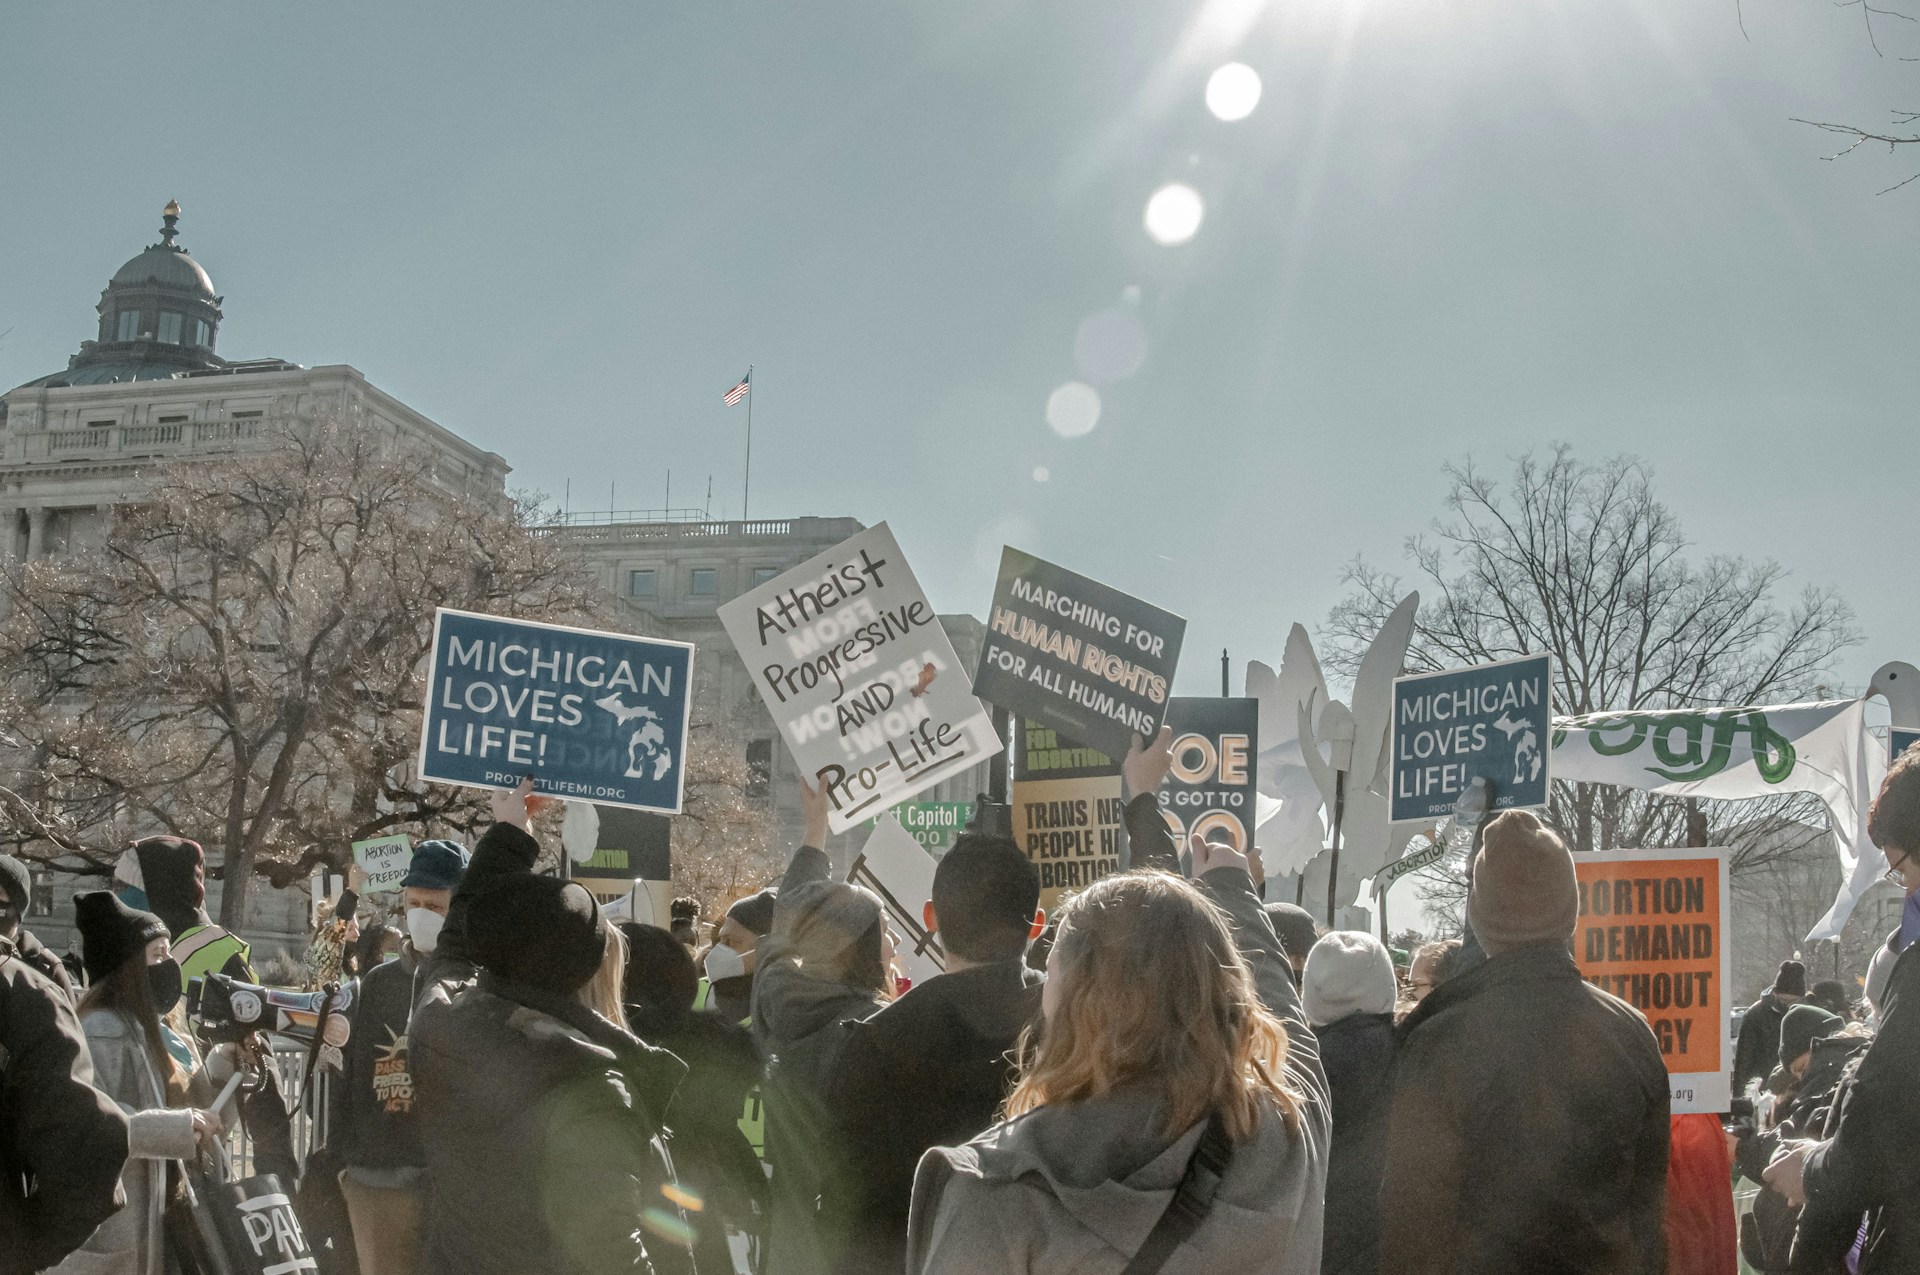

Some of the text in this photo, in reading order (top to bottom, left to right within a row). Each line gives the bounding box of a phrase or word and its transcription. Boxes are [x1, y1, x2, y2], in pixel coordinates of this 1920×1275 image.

[757, 549, 886, 646] Atheist
[1011, 577, 1165, 658] MARCHING FOR
[447, 635, 672, 697] MICHIGAN
[763, 601, 936, 703] Progressive
[992, 606, 1167, 705] HUMAN RIGHTS
[443, 676, 583, 726] LOVES
[836, 682, 894, 737] AND
[986, 645, 1027, 678] FOR
[1029, 665, 1063, 695] ALL
[1068, 680, 1155, 736] HUMANS
[1401, 677, 1539, 725] MICHIGAN
[438, 719, 547, 767] LIFE!
[1161, 732, 1249, 785] OE
[1400, 723, 1487, 761] LOVES
[816, 718, 962, 811] Pro-Life
[1399, 763, 1467, 798] LIFE!
[485, 771, 626, 799] PROTCTLIFEMI.ORG
[1176, 791, 1215, 806] GOT
[1218, 792, 1244, 806] TO
[907, 805, 957, 830] Capitol
[365, 843, 403, 861] ABORTION
[911, 831, 940, 845] 00
[1026, 830, 1094, 860] PEOPLE
[1387, 834, 1448, 880] ABORTION
[380, 860, 391, 869] IS
[1585, 924, 1713, 963] DEMAND
[373, 1072, 412, 1088] FREED
[375, 1060, 405, 1075] PASS
[376, 1086, 415, 1101] TO VO
[384, 1099, 411, 1113] ACT
